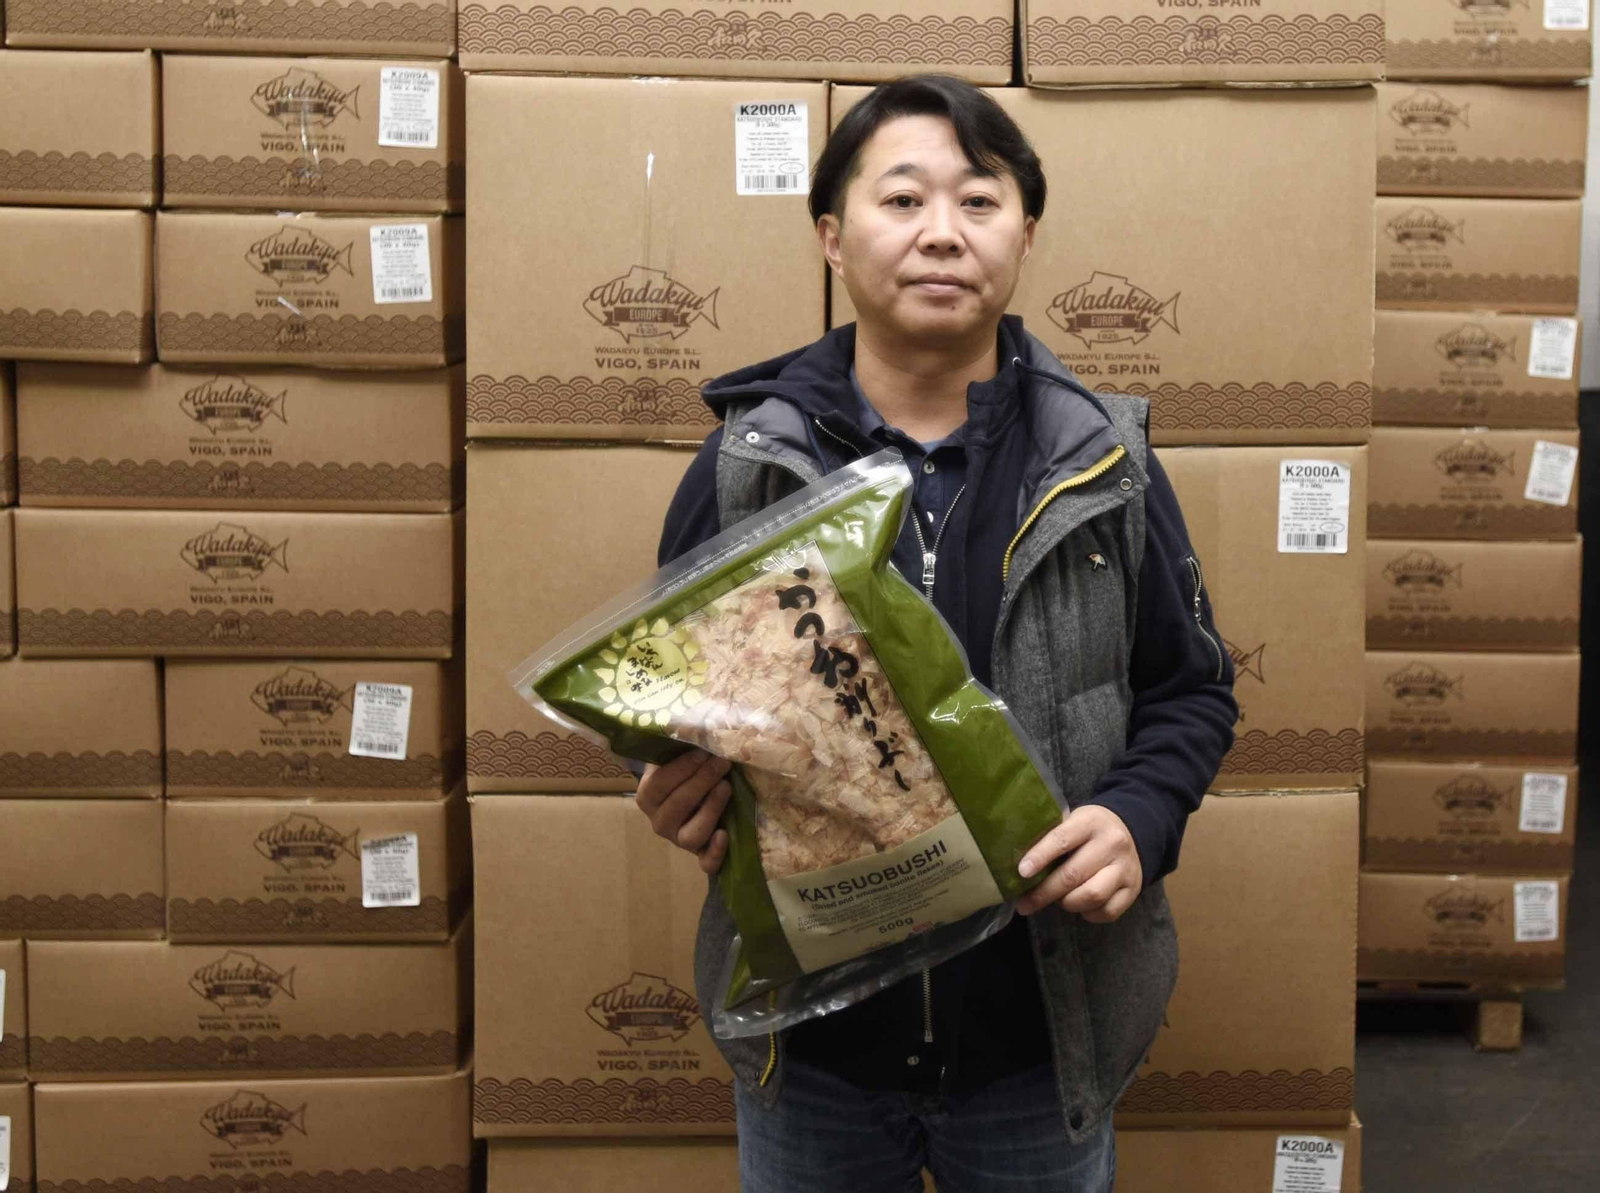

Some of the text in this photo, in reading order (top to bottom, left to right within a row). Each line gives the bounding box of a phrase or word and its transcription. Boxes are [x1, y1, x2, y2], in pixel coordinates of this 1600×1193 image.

[256, 78, 347, 105] Wadakyu
[740, 104, 797, 116] K2000A
[261, 142, 299, 153] VIGO,
[250, 237, 340, 265] Wadakyu
[590, 280, 704, 313] Wadakyu
[1052, 286, 1164, 319] Wadakyu
[629, 309, 663, 321] EUROPE
[1091, 315, 1124, 327] EUROPE
[595, 358, 700, 370] VIGO, SPAIN
[1065, 364, 1160, 375] IGO, SPAIN
[184, 383, 274, 409] Wadakyu
[189, 446, 272, 456] VIGO, SPAIN
[1286, 465, 1339, 477] K2000A
[185, 533, 275, 557] Wadakyu
[190, 595, 274, 605] VIGO, SPAIN
[797, 840, 947, 903] KATSUOBUSHI
[878, 917, 914, 934] 500g
[597, 1060, 700, 1071] VIGO, SPAIN
[1282, 1140, 1334, 1153] K2000A
